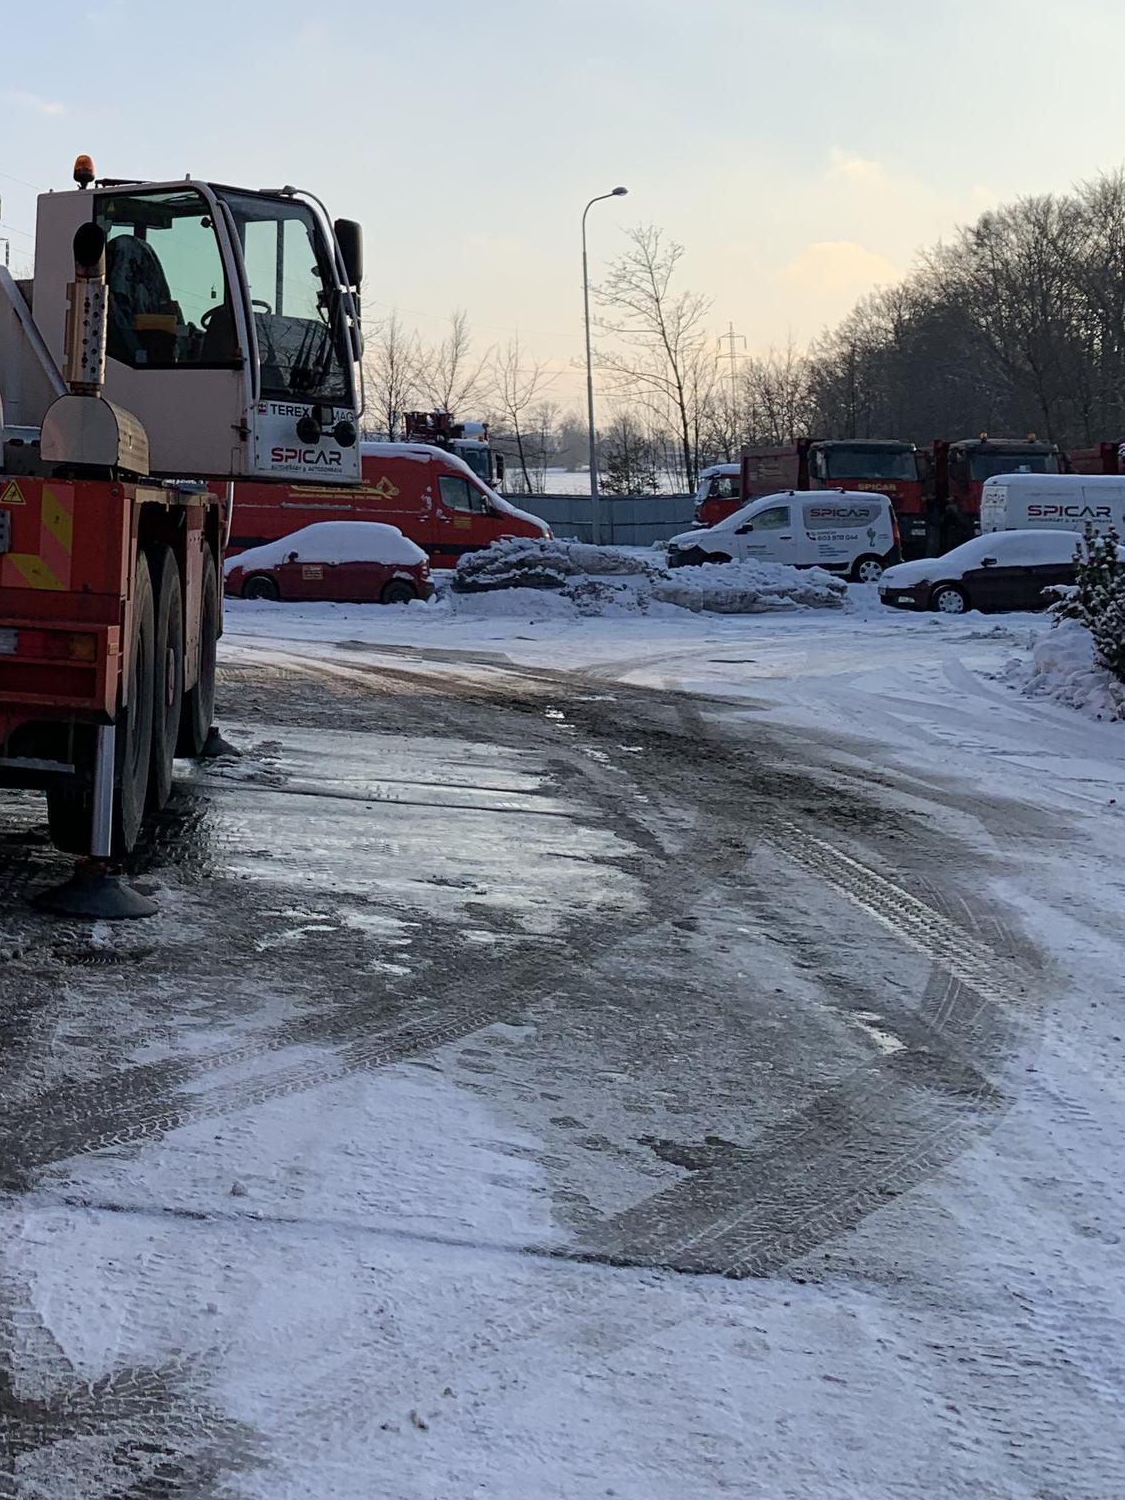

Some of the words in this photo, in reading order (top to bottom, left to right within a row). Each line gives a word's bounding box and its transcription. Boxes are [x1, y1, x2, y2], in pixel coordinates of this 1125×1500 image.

[270, 403, 310, 418] TEREX
[270, 447, 342, 466] SPICAR
[810, 508, 870, 518] SPICAR
[1027, 505, 1112, 518] SPICAR
